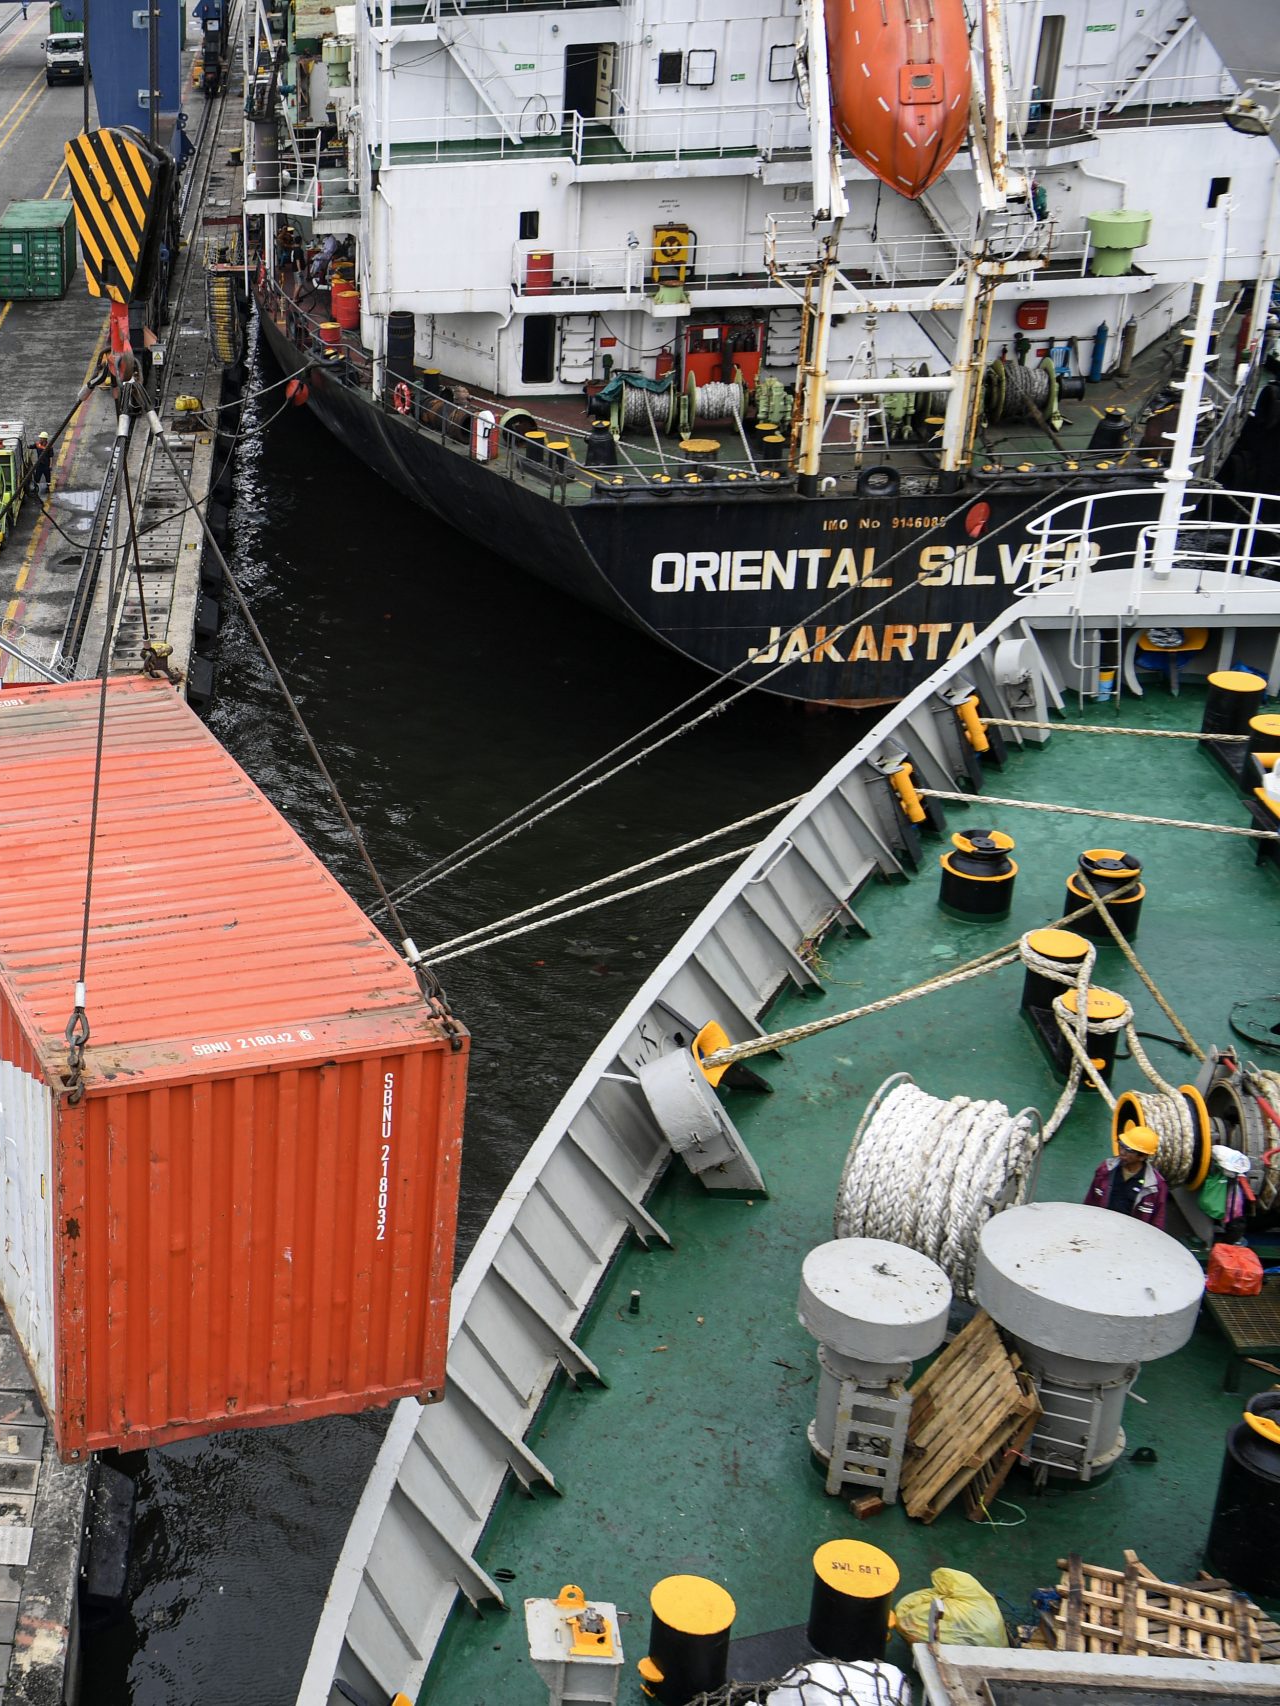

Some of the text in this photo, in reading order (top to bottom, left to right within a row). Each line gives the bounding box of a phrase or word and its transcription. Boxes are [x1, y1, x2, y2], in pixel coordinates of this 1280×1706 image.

[823, 519, 849, 531] IMO
[859, 518, 881, 529] No
[651, 548, 893, 593] ORIENTAL
[748, 621, 979, 665] JAKARTA
[192, 1041, 231, 1056] SBNU
[376, 1073, 394, 1240] SBNU 218032
[832, 1561, 854, 1573] SWL
